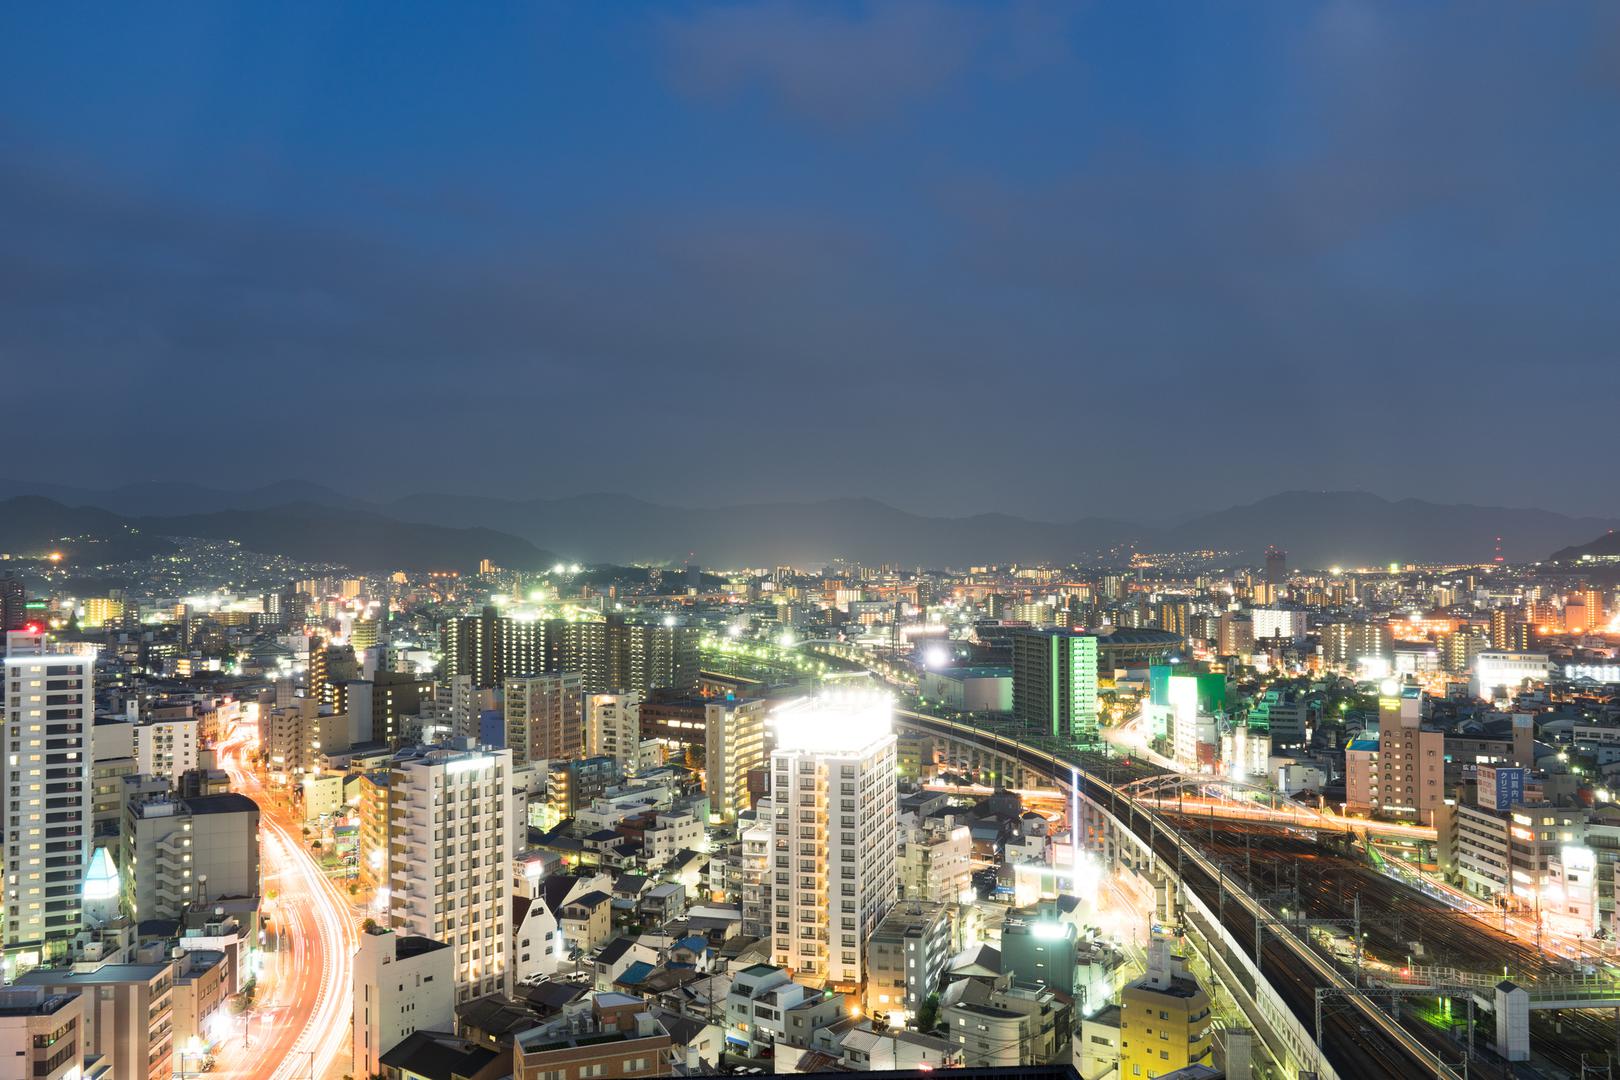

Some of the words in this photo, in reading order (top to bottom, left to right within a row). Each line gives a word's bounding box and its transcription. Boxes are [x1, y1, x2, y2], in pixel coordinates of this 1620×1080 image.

[1500, 772, 1508, 806] クリニック
